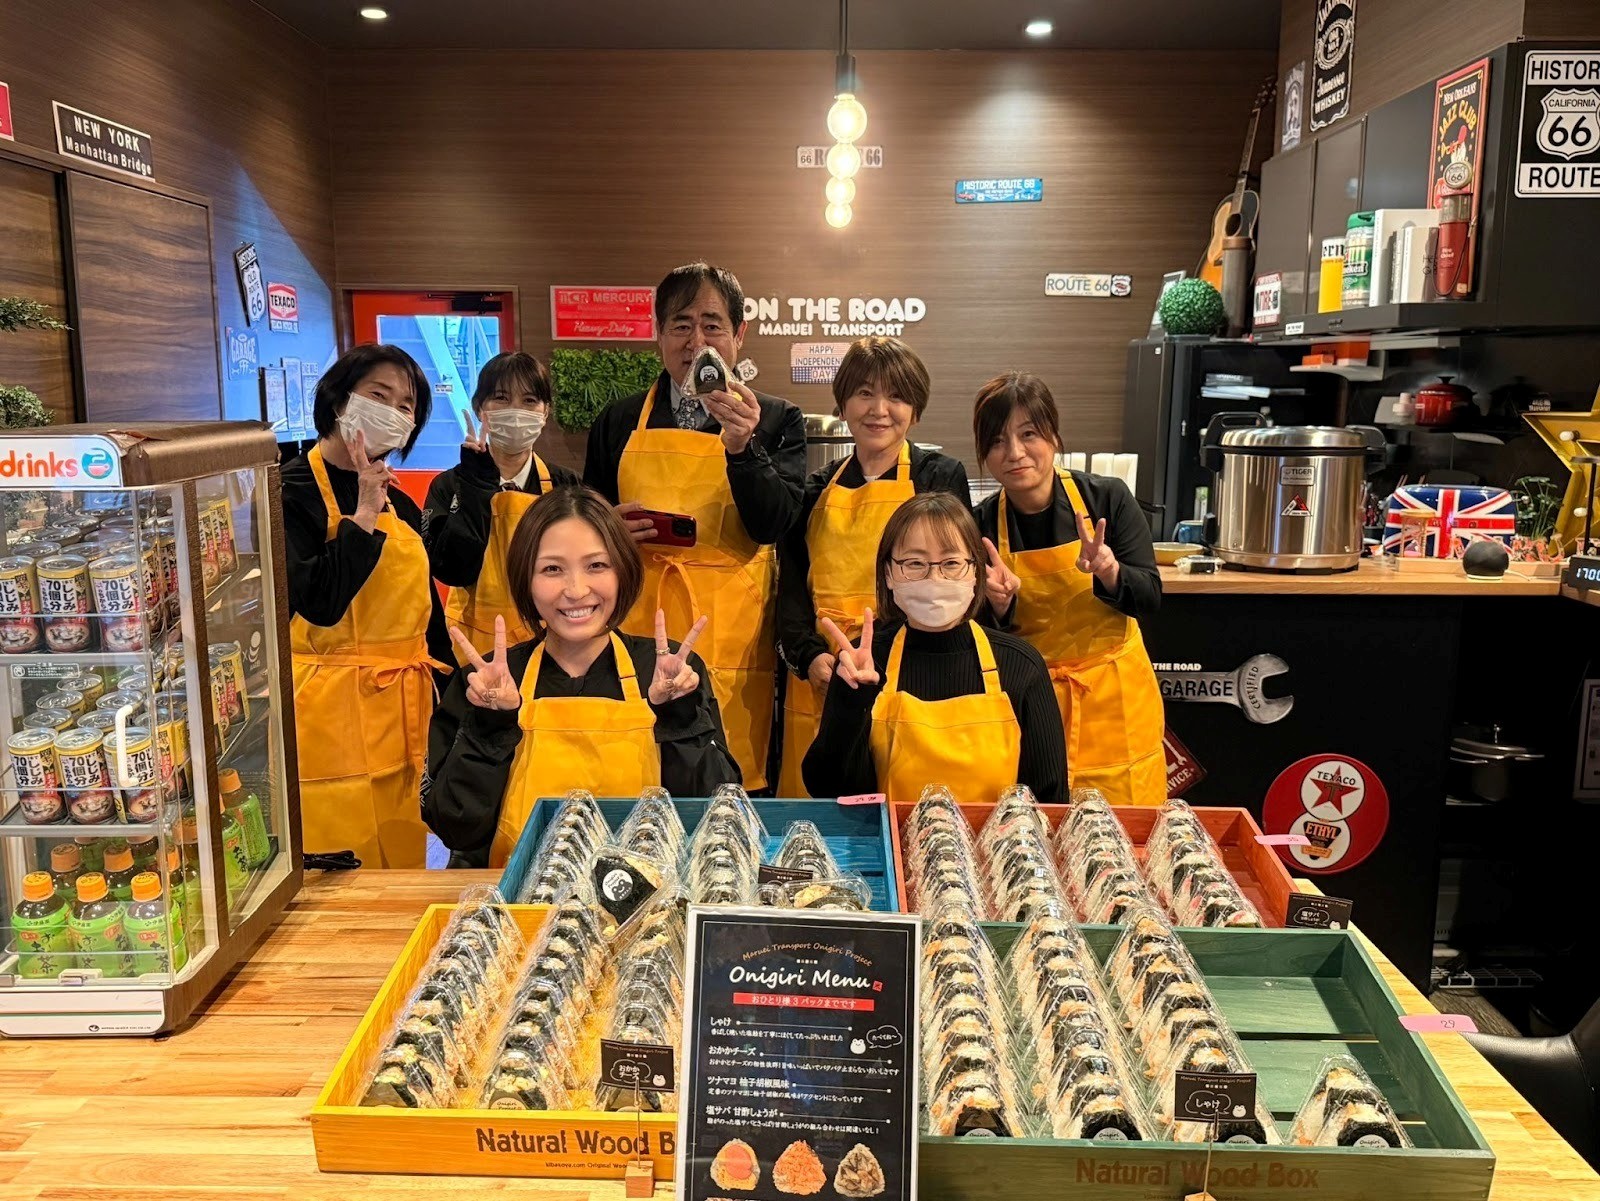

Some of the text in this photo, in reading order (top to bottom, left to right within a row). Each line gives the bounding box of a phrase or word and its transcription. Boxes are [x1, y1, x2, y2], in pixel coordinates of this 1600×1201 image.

[1531, 60, 1600, 80] HISTOR
[1314, 87, 1347, 114] WHISKEY
[1454, 82, 1477, 101] ORLEANS
[1549, 99, 1596, 107] CALIFORNIA
[1439, 100, 1477, 141] JAZZ CLUB
[74, 115, 141, 153] NEW YORK
[1548, 115, 1591, 147] 66
[65, 136, 152, 176] Manhattan Bridge
[800, 155, 812, 164] 66
[866, 148, 881, 166] 66
[963, 181, 997, 190] HISTORIC
[997, 180, 1022, 190] ROUTE
[1450, 173, 1463, 182] 66
[1528, 166, 1600, 189] ROUTE
[1046, 279, 1091, 291] ROUTE
[1094, 279, 1110, 291] 66
[251, 292, 263, 316] 66
[270, 294, 296, 309] TEXACO
[592, 292, 651, 303] MERCURY
[743, 297, 926, 322] ON THE ROAD
[759, 323, 905, 337] MARUEI TRANSPORT
[231, 337, 257, 363] GARAGE
[809, 346, 835, 354] HAPPY
[795, 357, 844, 367] INDEPENDEN
[743, 366, 755, 379] 66
[811, 369, 831, 380] DAY
[0, 450, 78, 477] drinks
[4, 584, 20, 612] しじみ
[46, 580, 62, 611] 70個分
[62, 584, 76, 611] しじみ
[102, 580, 120, 611] 70個分
[120, 582, 134, 609] しじみ
[1153, 663, 1202, 671] THE ROAD
[1160, 679, 1233, 697] GARAGE
[1246, 666, 1261, 710] CERTIFIED
[14, 756, 29, 786] 70個分
[28, 761, 43, 786] しじみ
[68, 756, 87, 786] 70個分
[86, 757, 100, 782] しじみ
[1316, 770, 1356, 786] TEXACO
[1167, 768, 1192, 793] VICE
[1324, 782, 1343, 801] T
[1305, 822, 1338, 840] ETHYL
[742, 942, 873, 967] Maruei Transport Onigiri Project
[729, 966, 807, 989] Onigiri
[812, 969, 871, 988] Menu
[710, 1016, 732, 1027] しゃけ
[1440, 1020, 1455, 1029] 29
[708, 1045, 757, 1056] おかかチーズ
[707, 1075, 738, 1086] ツナマヨ
[705, 1104, 779, 1118] 塩サバ 甘酢しょうが
[1195, 1098, 1221, 1109] しゃけ
[476, 1128, 568, 1154] Natural
[575, 1130, 650, 1155] Wood
[1075, 1158, 1320, 1189] Natural Wood Box
